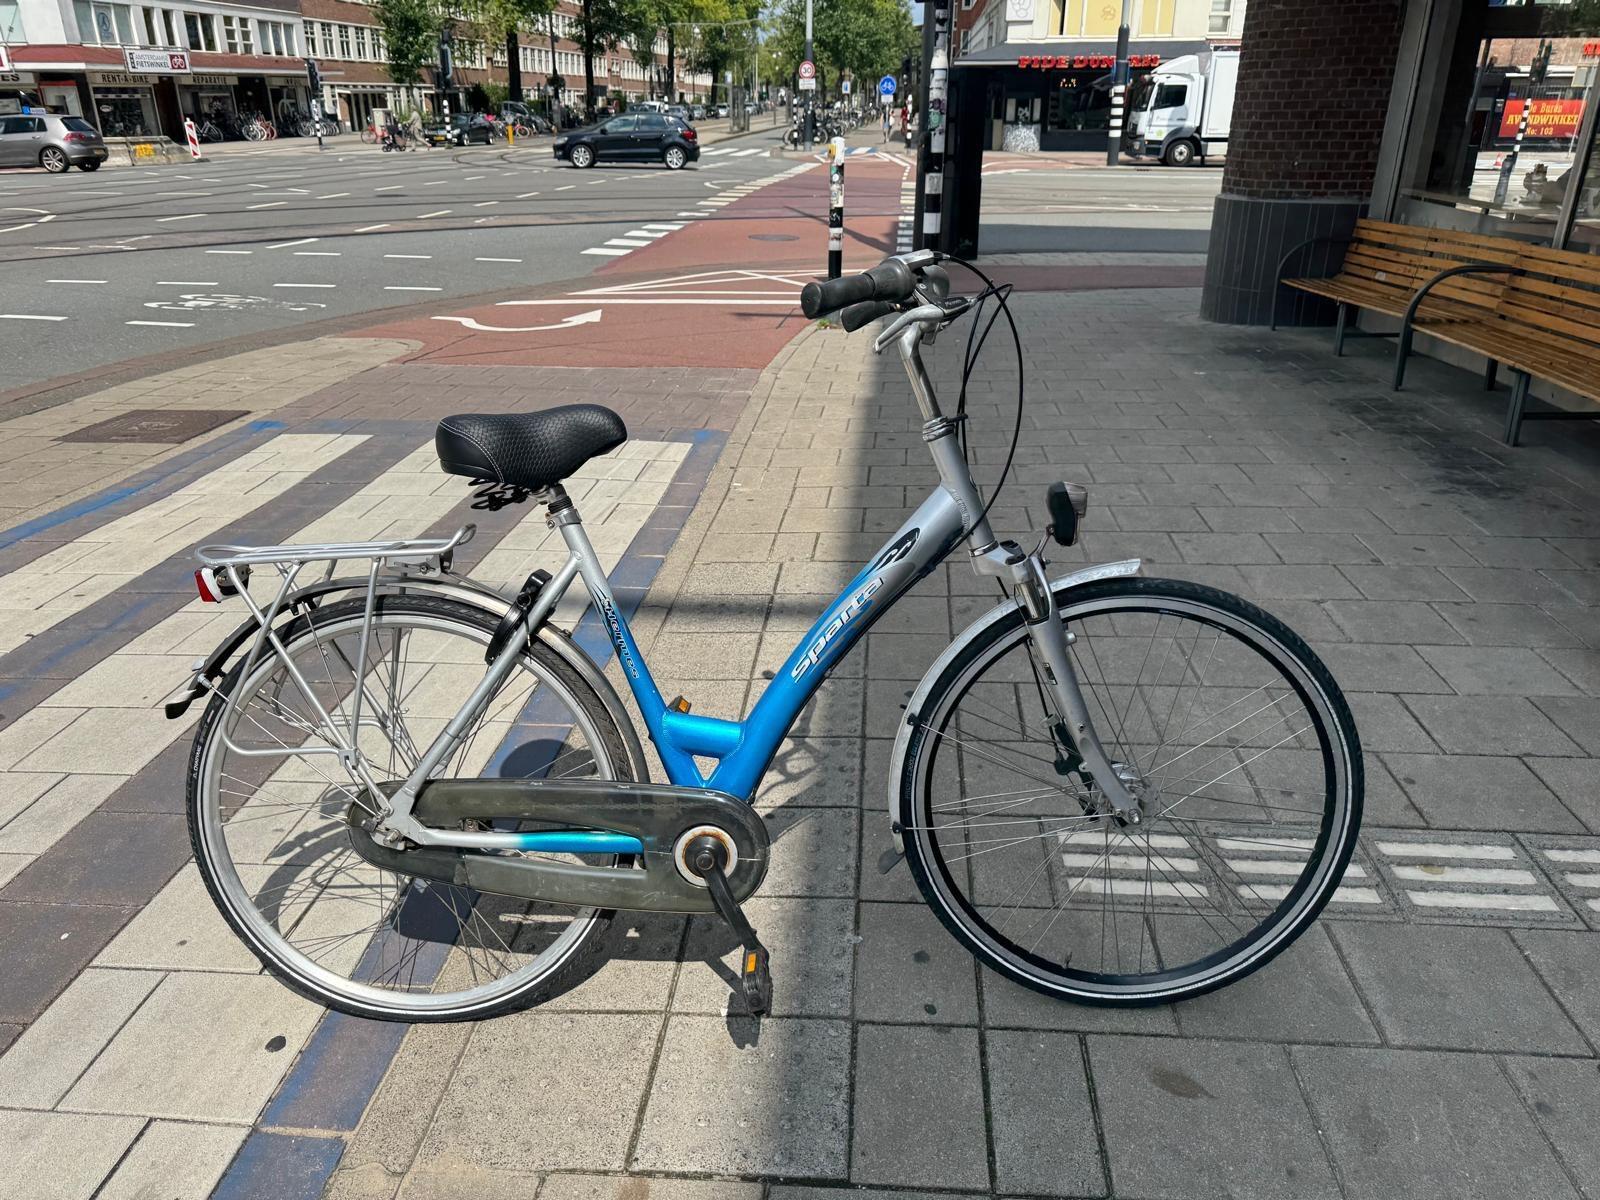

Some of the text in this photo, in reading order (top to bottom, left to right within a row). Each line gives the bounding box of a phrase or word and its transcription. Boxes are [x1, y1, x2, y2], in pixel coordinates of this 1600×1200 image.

[136, 60, 169, 68] FIETSWINKEL
[1018, 53, 1161, 68] PIDE DÜNASI
[192, 76, 227, 84] REPARATIE
[1506, 114, 1578, 125] AVNDWINKEL
[1540, 127, 1553, 135] 102
